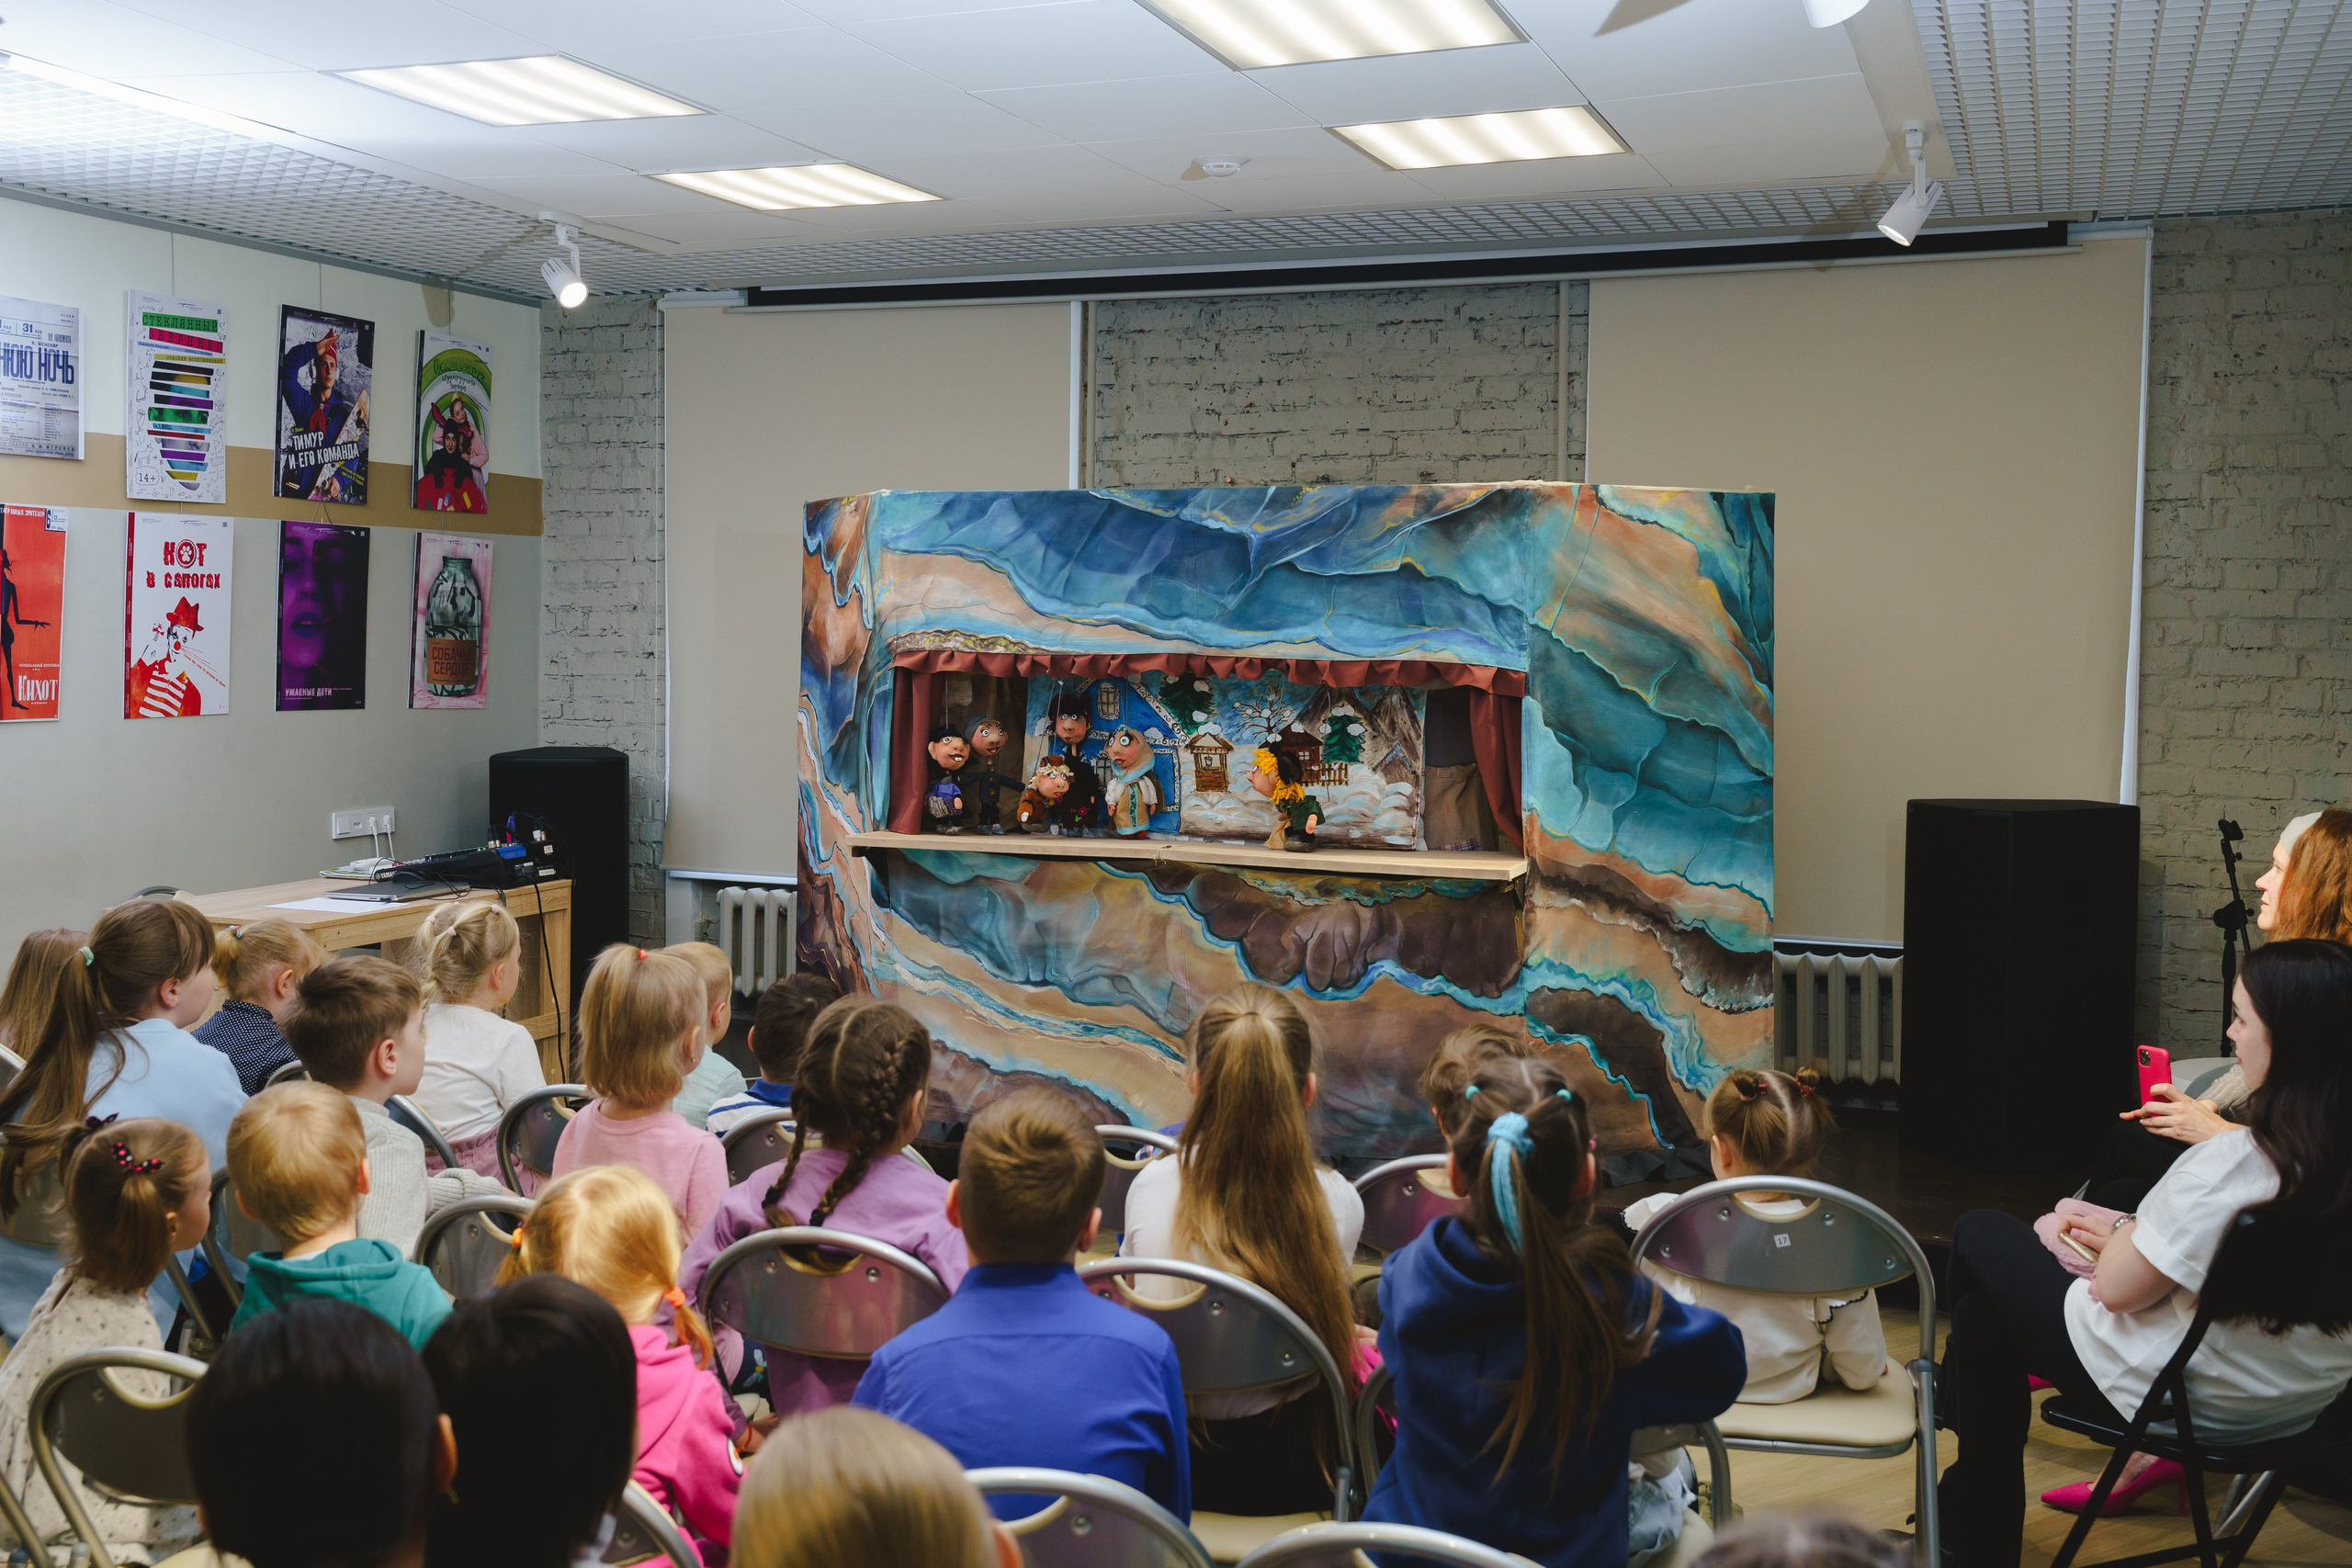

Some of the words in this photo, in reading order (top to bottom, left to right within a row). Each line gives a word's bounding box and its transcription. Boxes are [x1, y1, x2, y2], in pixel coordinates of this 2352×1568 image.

[23, 323, 33, 333] 31
[142, 314, 218, 332] СТЕКЛЯННЫЙ
[38, 347, 74, 384] НОЧЬ
[292, 431, 324, 451] ТИМУР
[288, 453, 296, 470] И
[298, 451, 315, 468] ЕГО
[317, 443, 359, 464] КОМАНДА
[139, 473, 156, 482] 14+
[46, 509, 51, 529] 6
[164, 572, 220, 589] сапогах
[432, 647, 473, 661] СОБАЧЬЕ
[434, 661, 469, 677] СЕРДЦЕ
[317, 688, 332, 697] ДЕТИ
